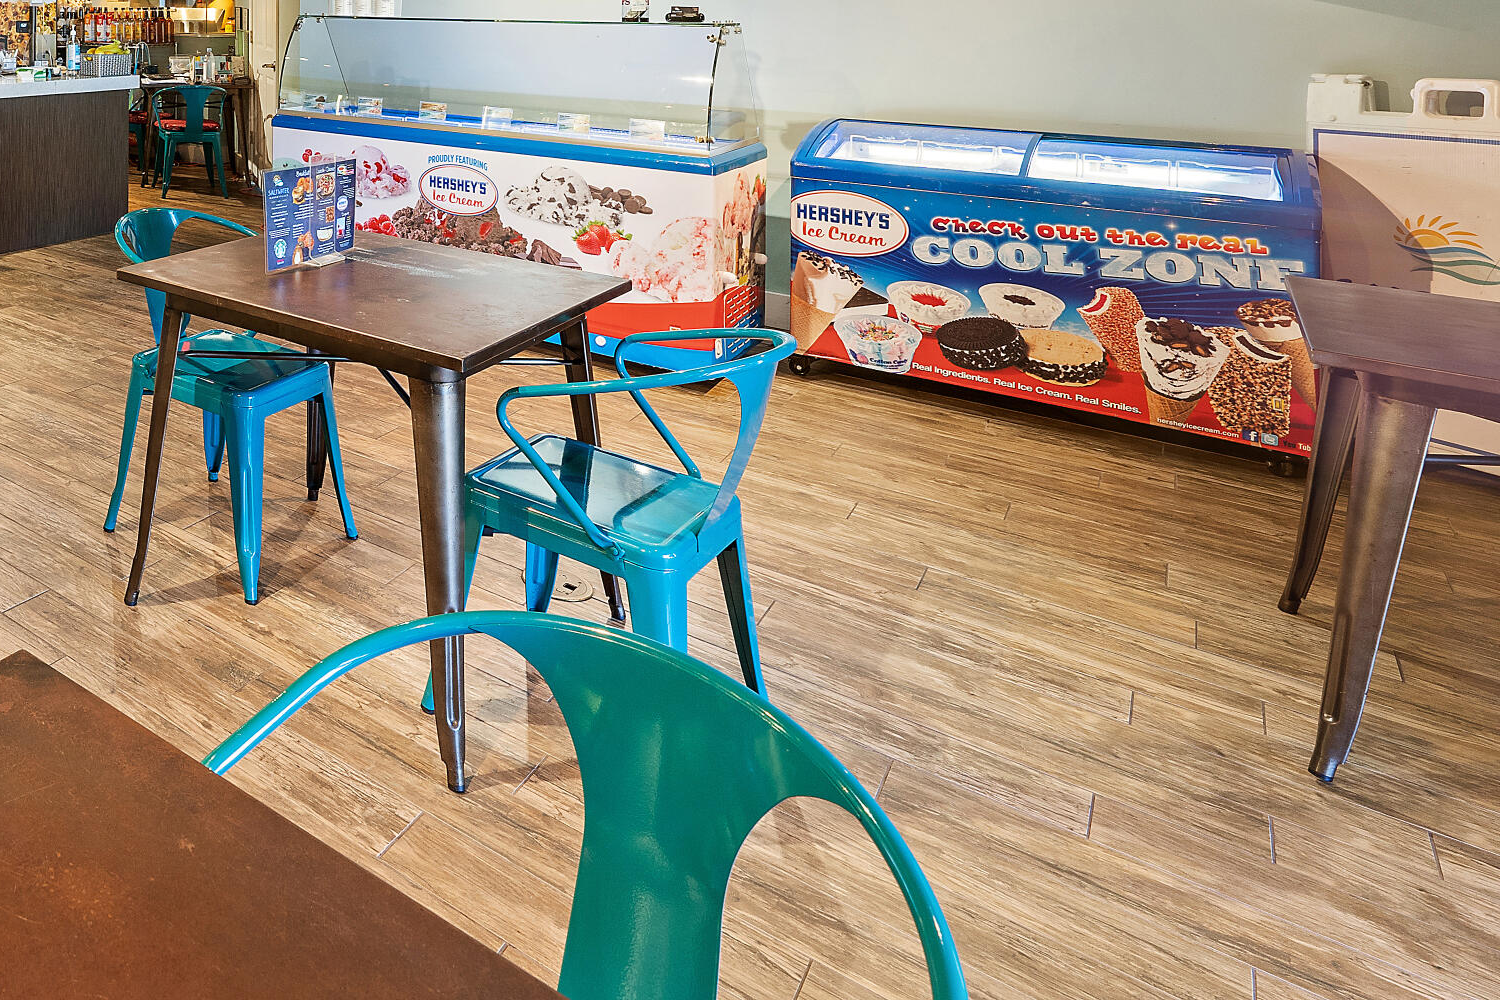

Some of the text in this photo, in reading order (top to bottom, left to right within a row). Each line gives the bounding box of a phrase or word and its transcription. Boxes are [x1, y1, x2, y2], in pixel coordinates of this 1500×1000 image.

[428, 155, 488, 171] PROUDLY FEATURING
[267, 188, 289, 196] SALTWATER
[429, 175, 486, 195] HERSHEY'S
[433, 189, 484, 208] Ice Cream
[796, 202, 890, 230] HERSHEY'S
[802, 221, 887, 247] Ice Cream
[1036, 223, 1098, 242] out
[1106, 227, 1169, 248] the
[911, 236, 1086, 277] COOL
[912, 361, 933, 373] Real
[934, 365, 991, 385] Ingredients.
[993, 377, 1017, 389] Real
[1018, 383, 1034, 393] Ice
[1035, 386, 1073, 401] Cream.
[1074, 393, 1100, 405] Real
[1101, 398, 1142, 415] Smiles.
[1157, 417, 1239, 439] hersheyicecream.com
[1299, 442, 1311, 452] Tub
